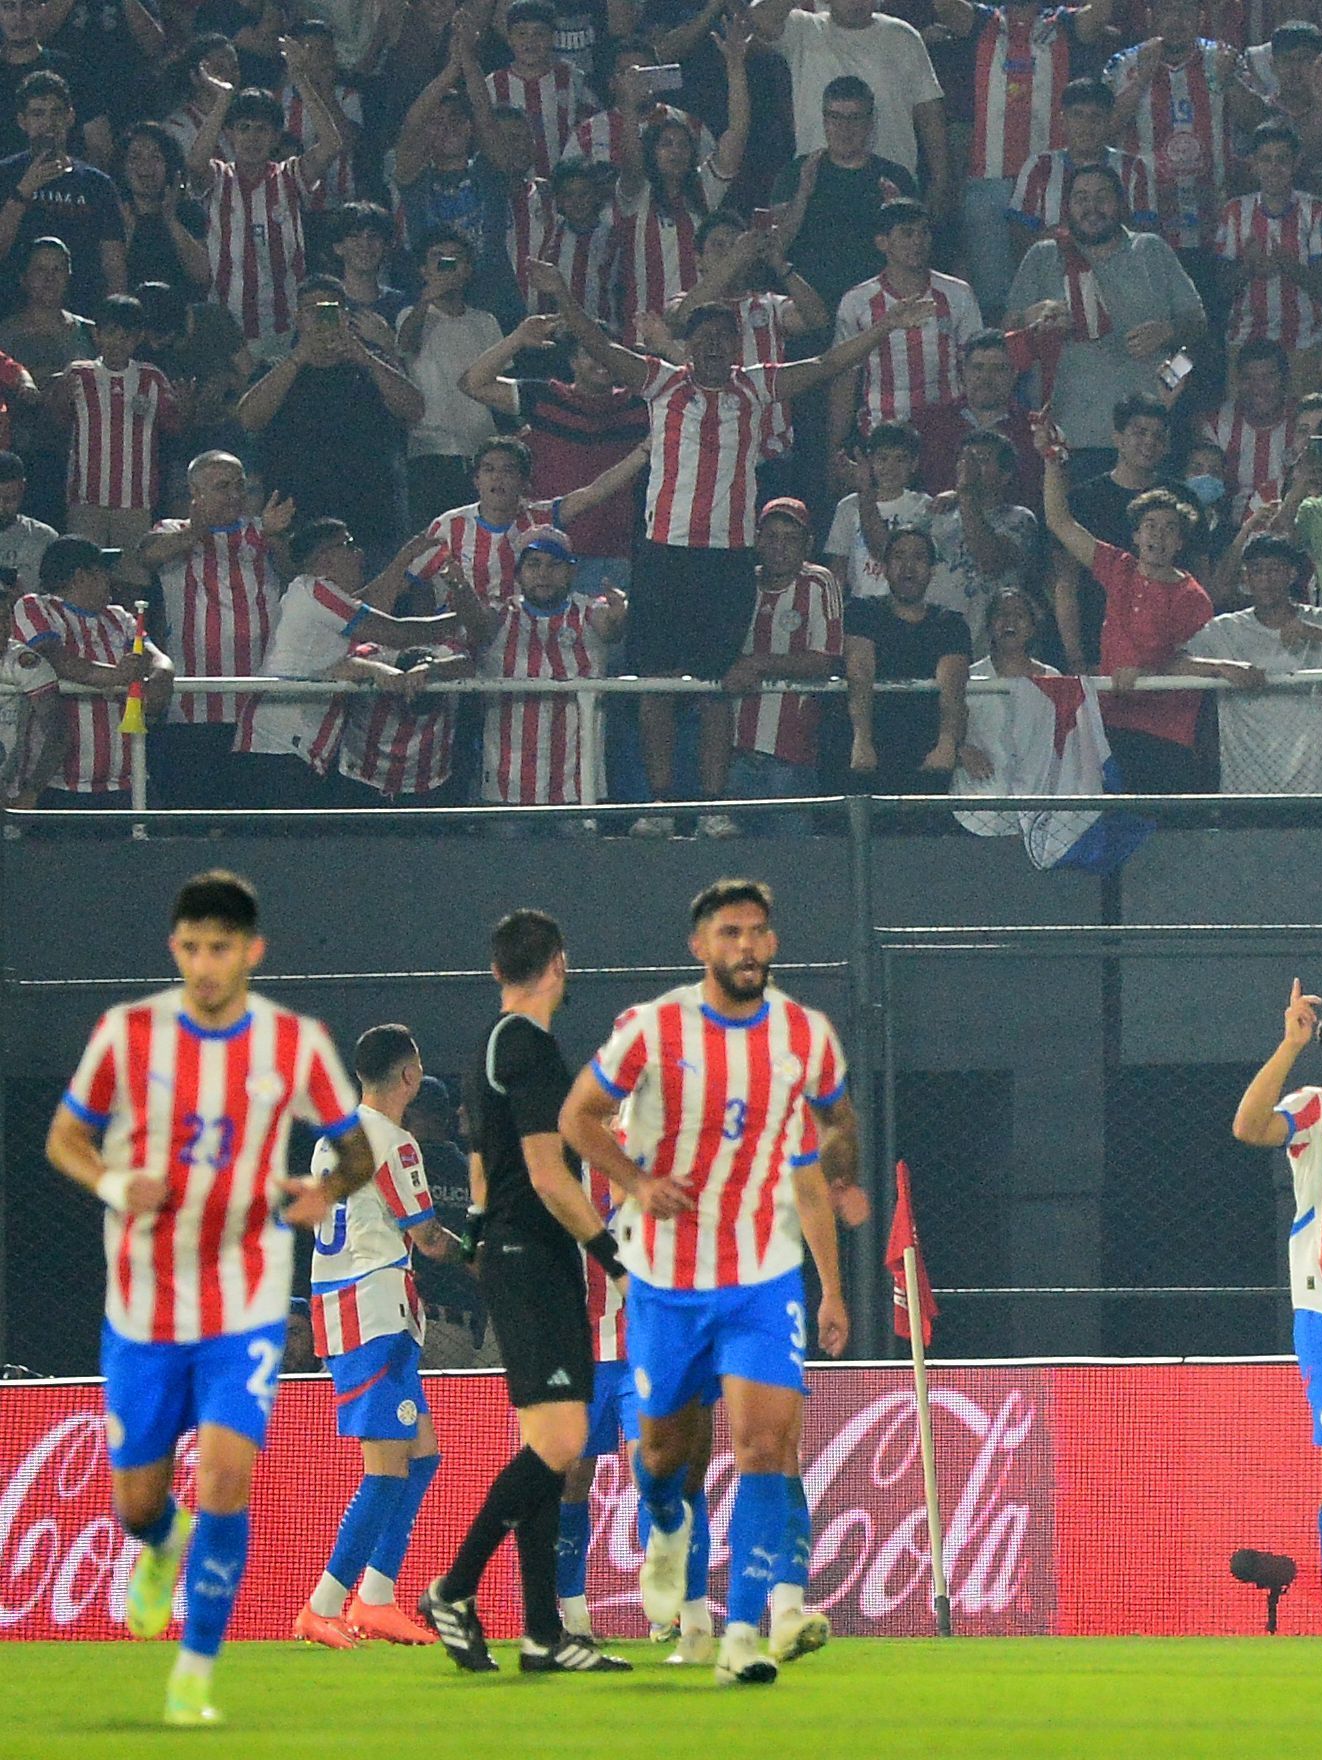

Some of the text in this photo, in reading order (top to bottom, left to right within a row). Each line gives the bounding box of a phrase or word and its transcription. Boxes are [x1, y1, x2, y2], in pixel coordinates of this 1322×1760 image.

[180, 1112, 233, 1170] 23
[723, 1097, 746, 1141] 3
[785, 1301, 806, 1349] 3
